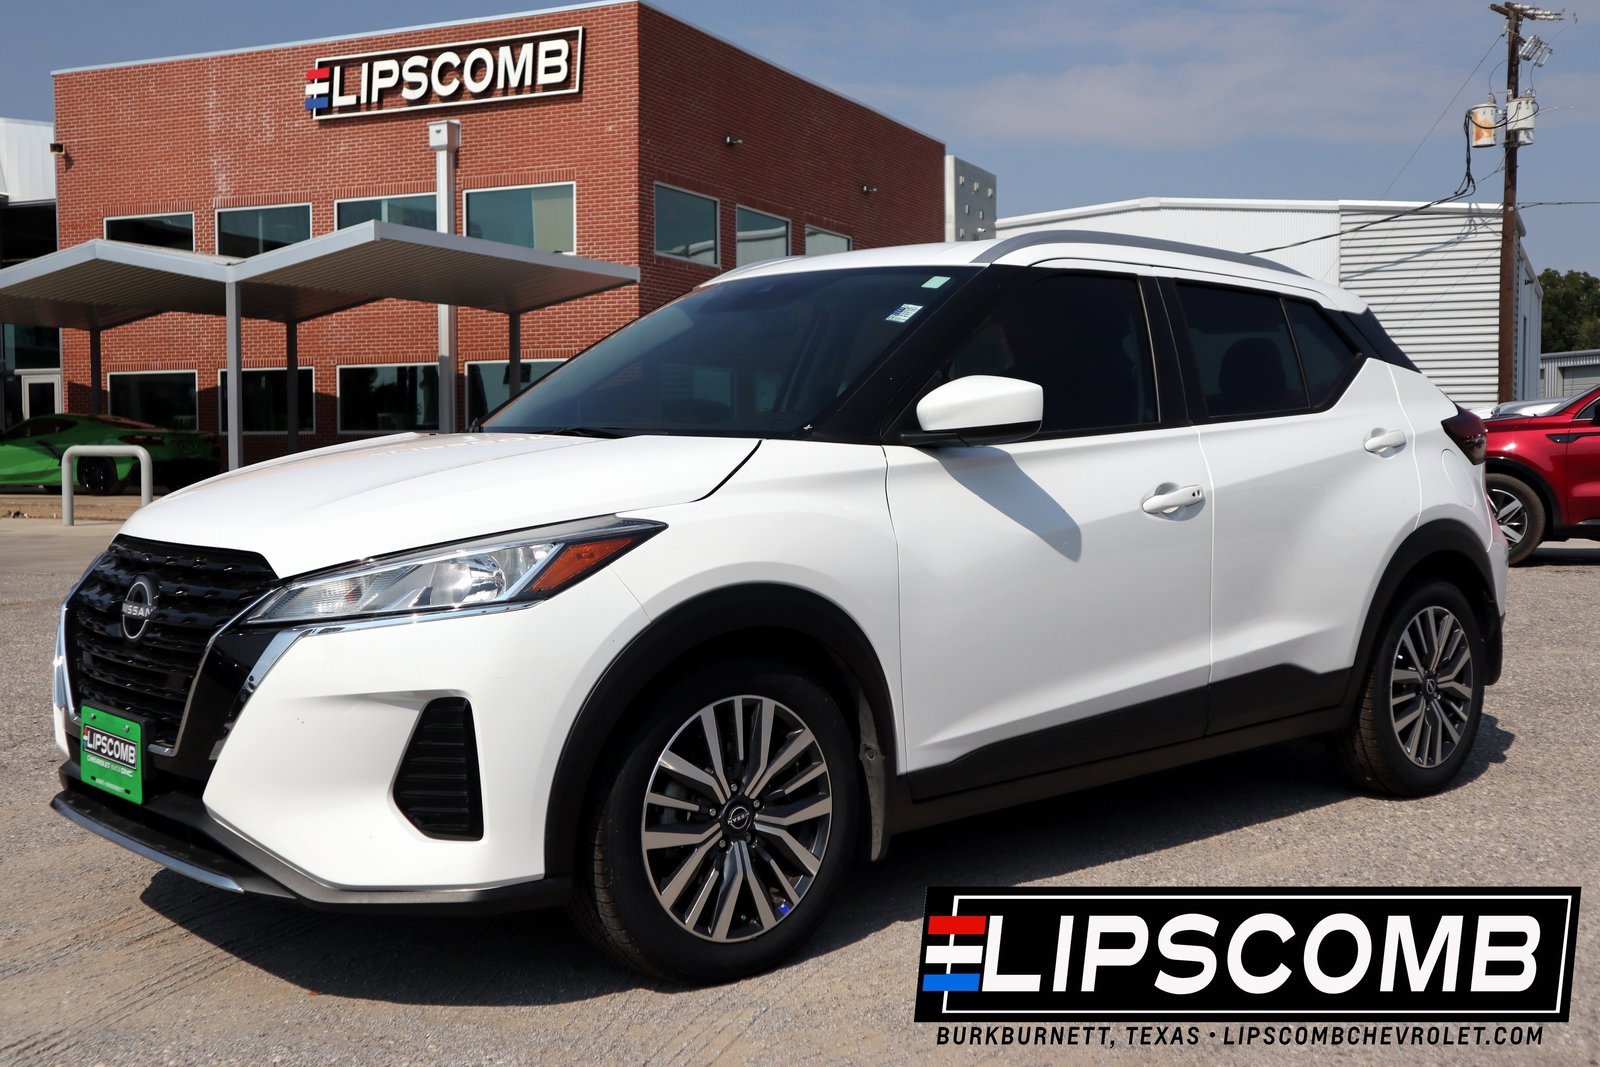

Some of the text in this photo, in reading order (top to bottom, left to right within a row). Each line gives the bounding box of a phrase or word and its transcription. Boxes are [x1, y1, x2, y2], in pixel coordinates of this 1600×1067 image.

[332, 39, 569, 107] LIPSCOMB
[122, 603, 155, 617] NISSAN
[86, 730, 136, 765] LIPSCOMB
